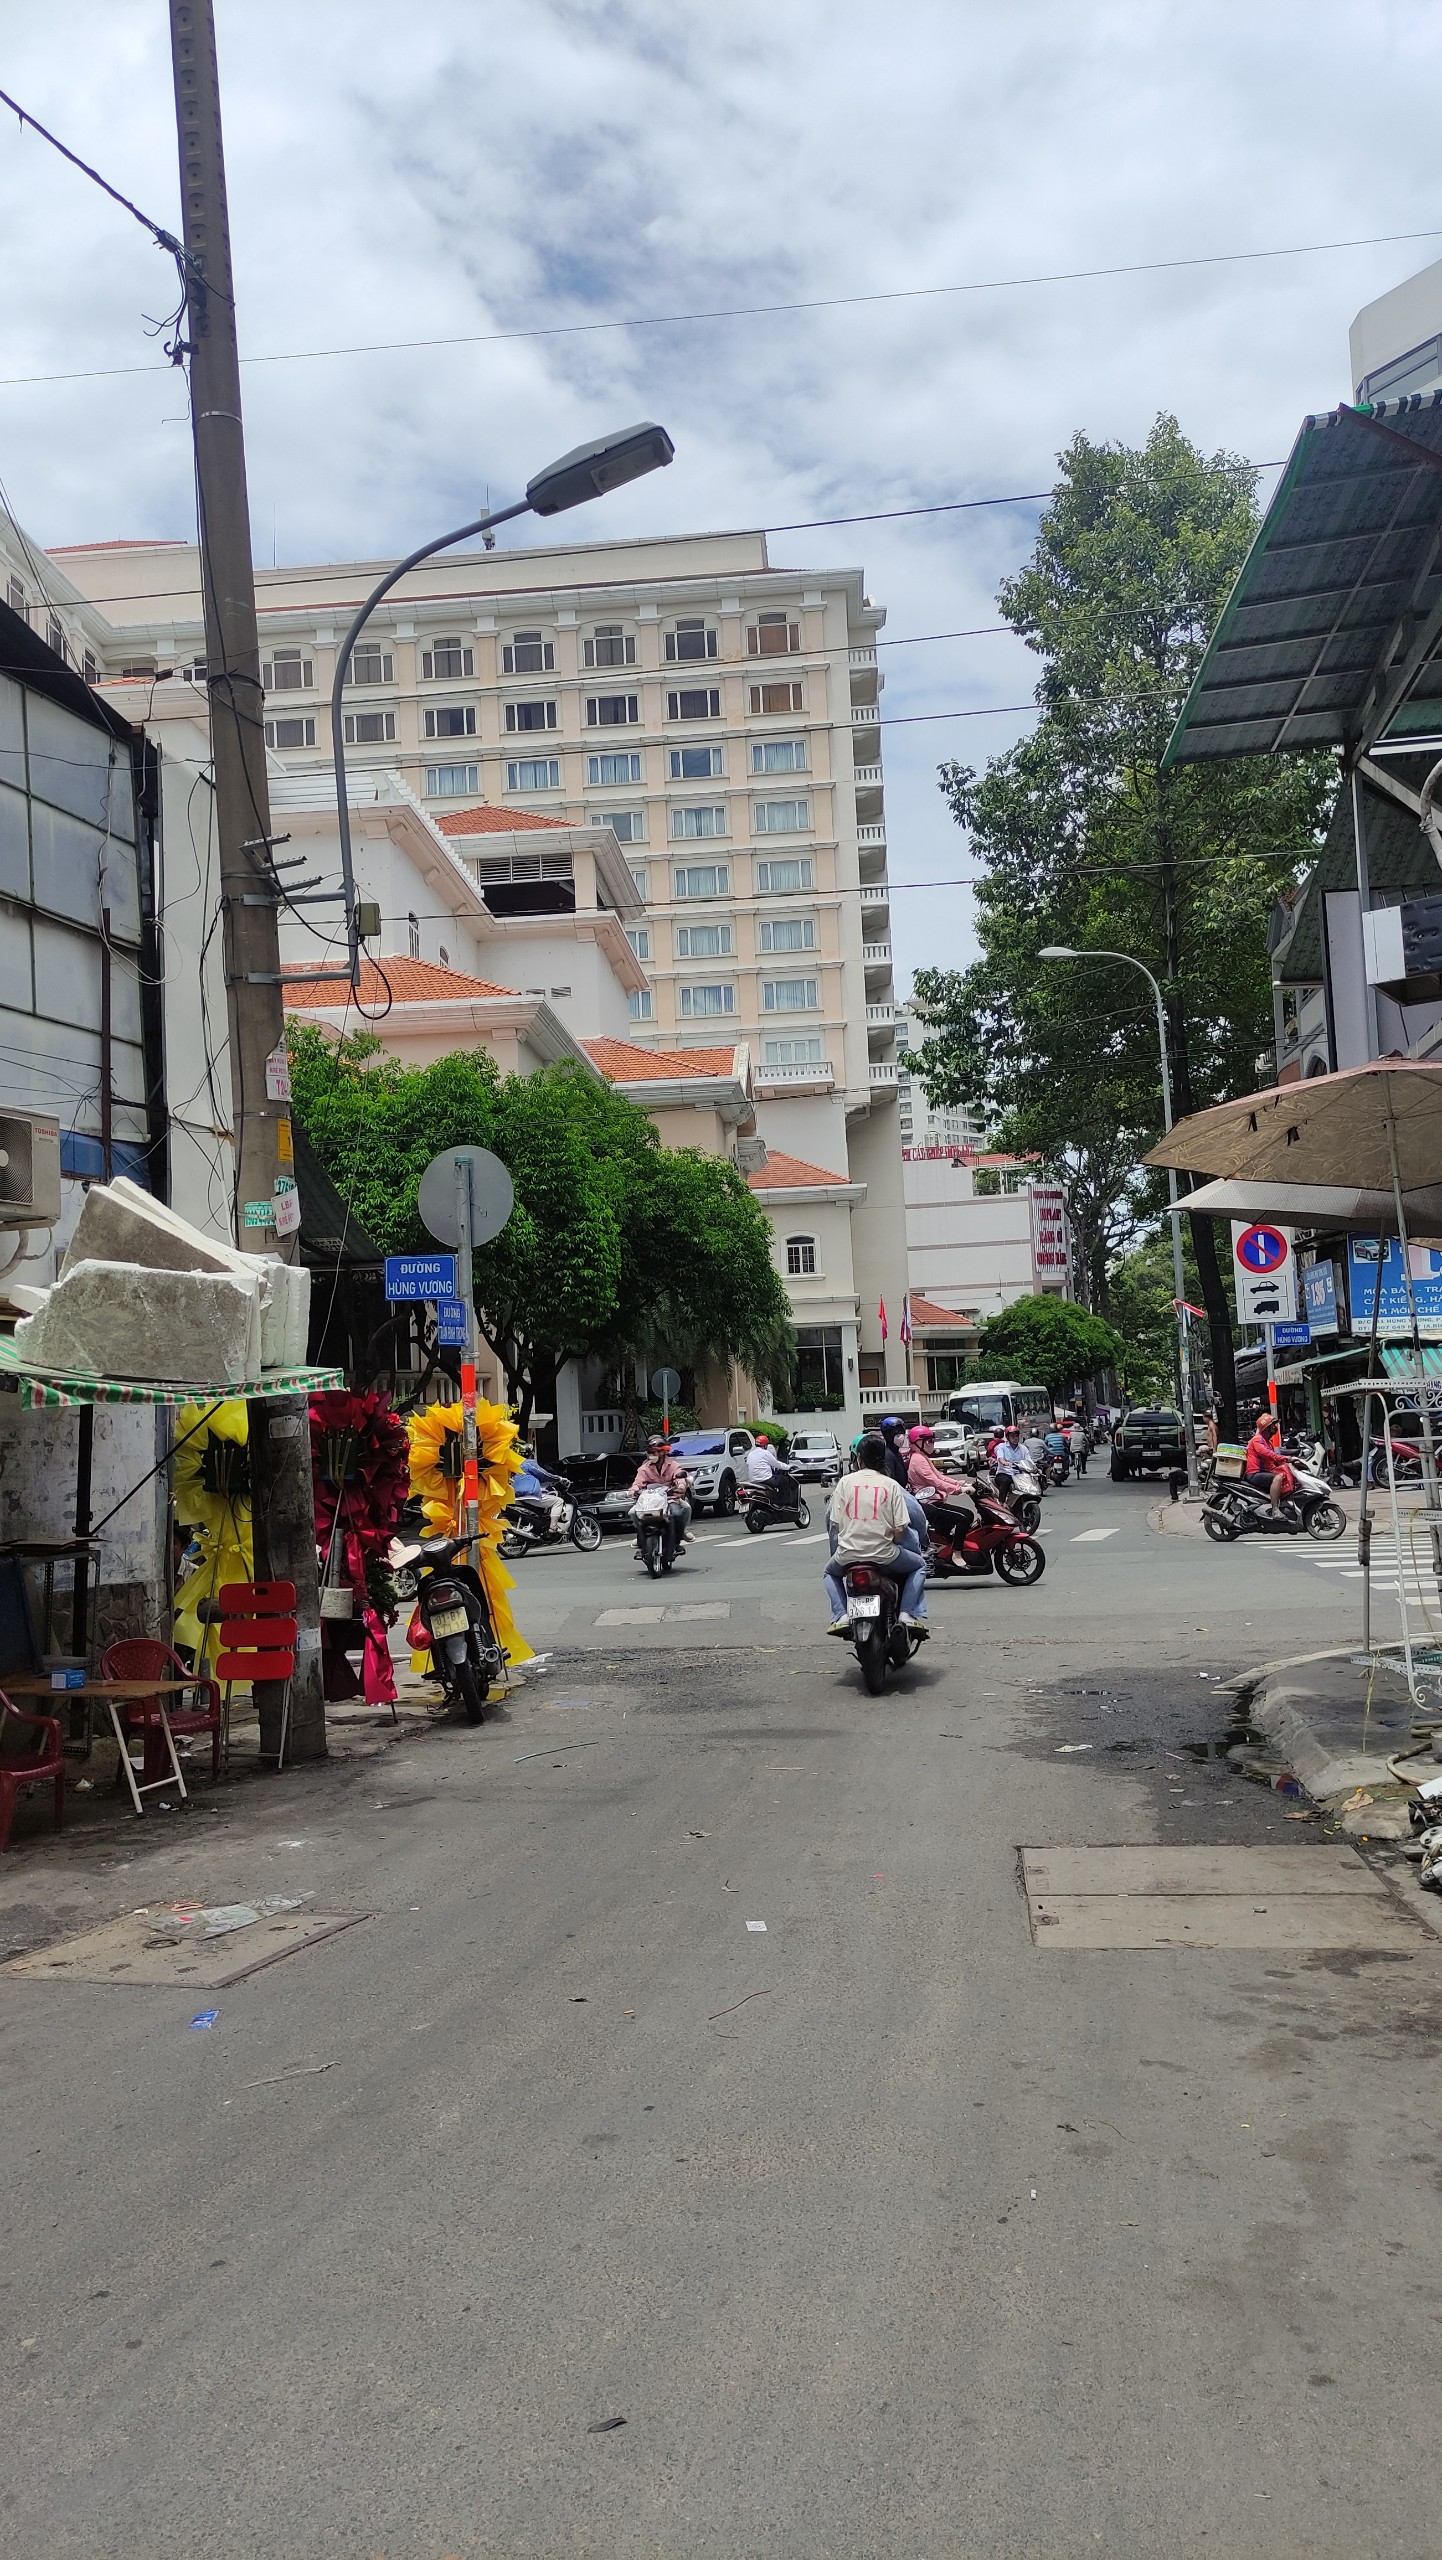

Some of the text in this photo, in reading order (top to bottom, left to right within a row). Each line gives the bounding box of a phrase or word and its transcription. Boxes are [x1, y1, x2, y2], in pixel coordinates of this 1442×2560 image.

[34, 1127, 58, 1137] TOSHIBA
[400, 1261, 441, 1274] ĐƯỜNG
[388, 1279, 453, 1296] HÙNG VƯƠNG
